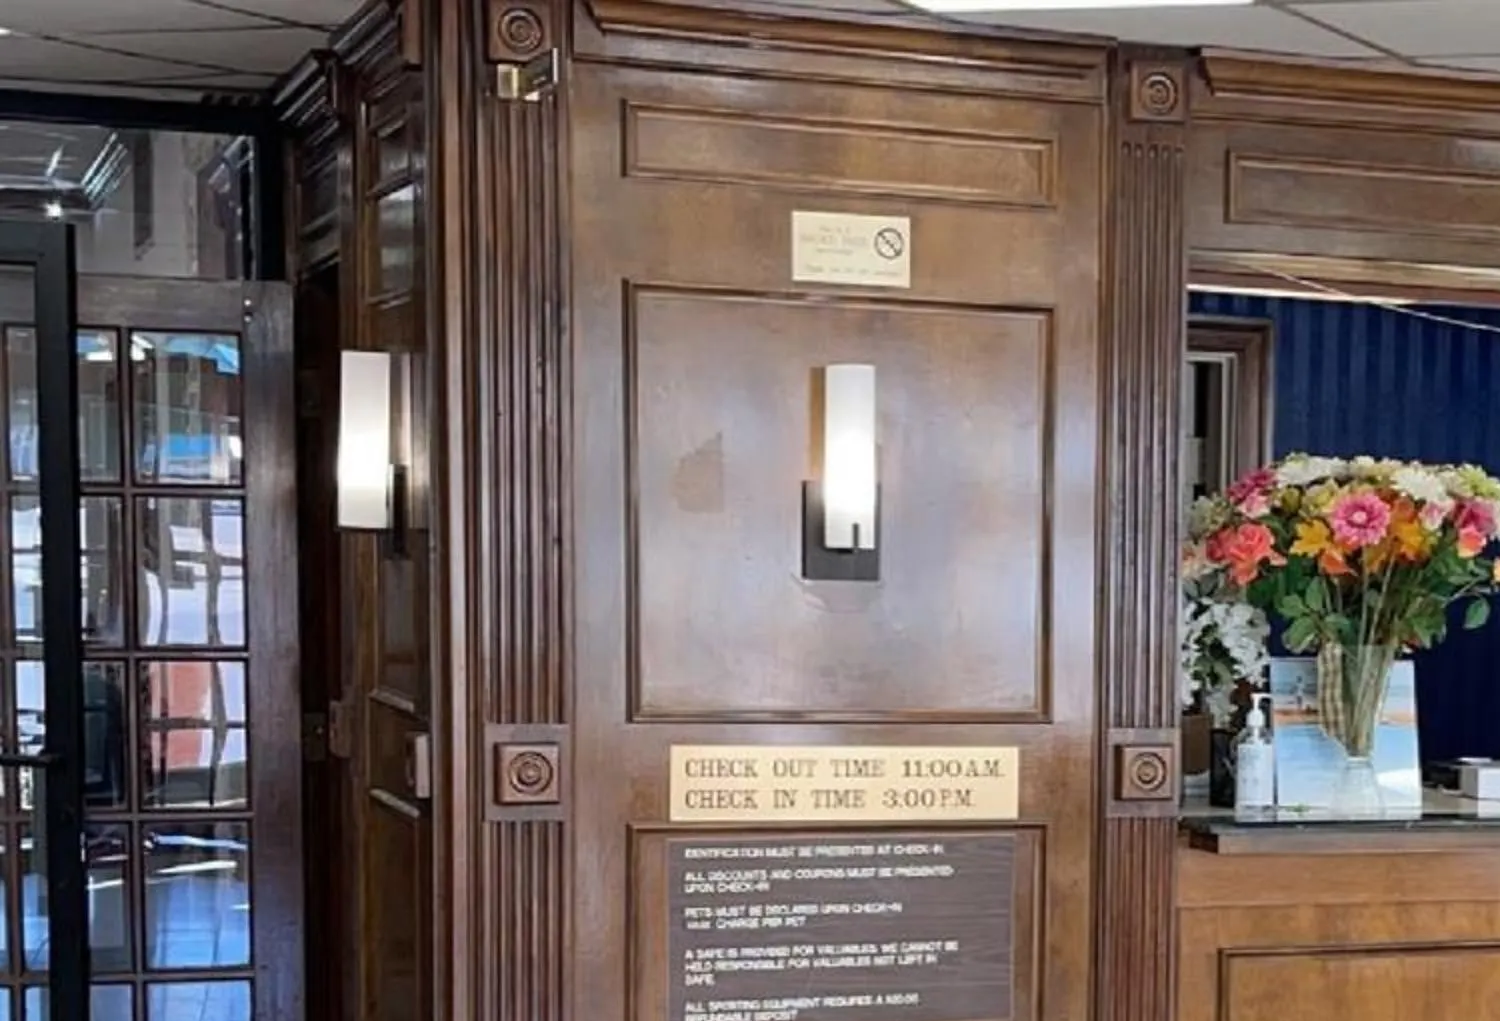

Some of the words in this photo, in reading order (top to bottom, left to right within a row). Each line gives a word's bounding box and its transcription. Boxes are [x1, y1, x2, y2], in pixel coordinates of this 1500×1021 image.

[685, 758, 759, 778] CHECK
[773, 758, 818, 778] OUT
[830, 758, 886, 778] TIME
[685, 789, 759, 809] CHECK
[773, 789, 799, 809] IN
[811, 789, 867, 809] TIME
[766, 846, 796, 857] MUST
[877, 844, 891, 855] AT
[685, 871, 706, 882] ALL
[846, 867, 876, 877] MUST
[685, 883, 714, 893] UPON
[715, 905, 746, 917] MUST
[685, 949, 693, 960] A
[792, 945, 814, 956] FOR
[685, 1001, 706, 1013] ALL
